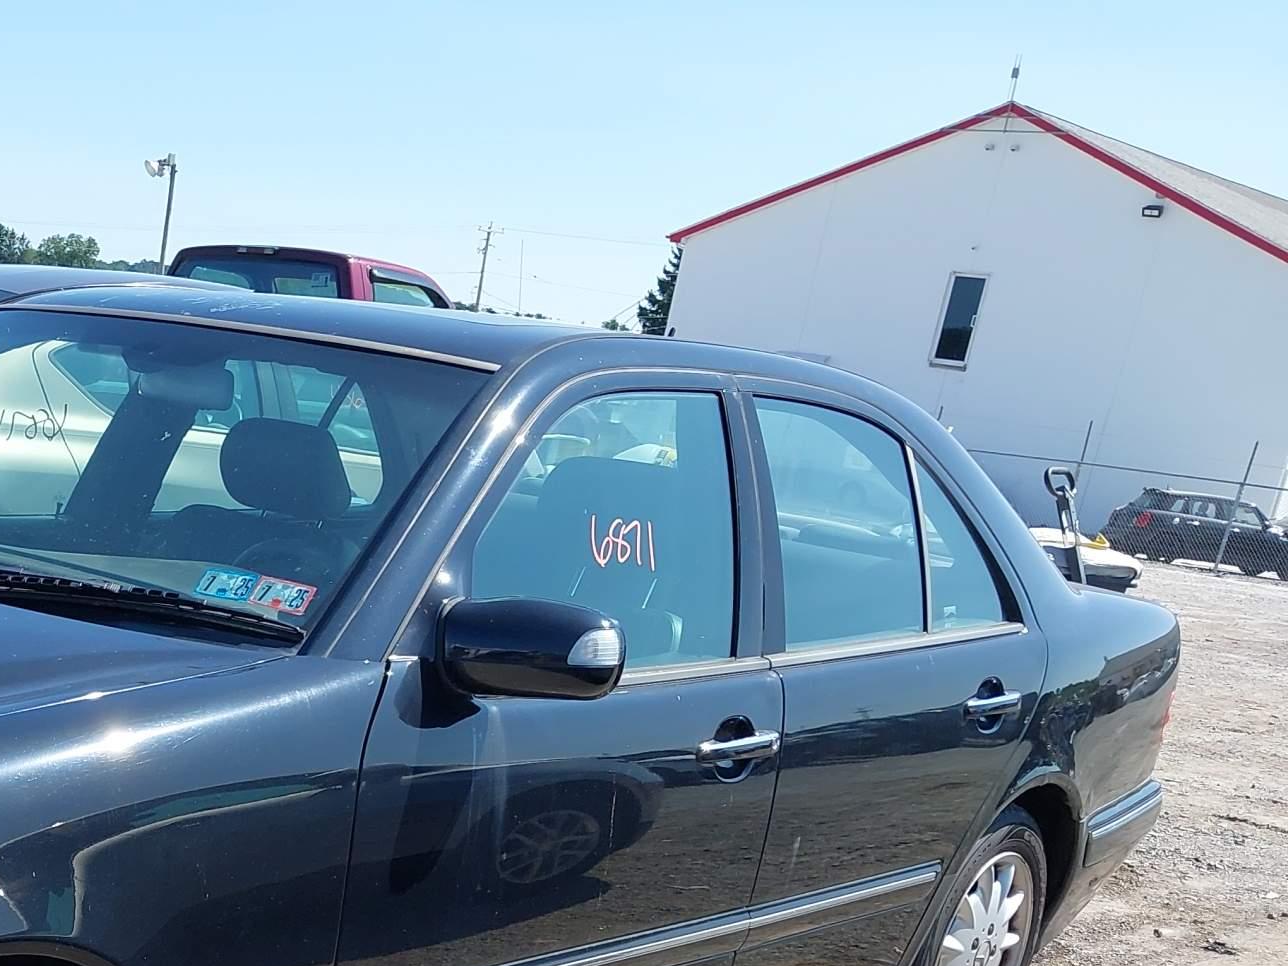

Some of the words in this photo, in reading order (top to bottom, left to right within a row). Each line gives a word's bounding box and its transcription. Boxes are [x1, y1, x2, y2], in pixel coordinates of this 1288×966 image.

[591, 514, 656, 572] 6871
[233, 577, 254, 596] 25
[287, 588, 310, 609] 25
